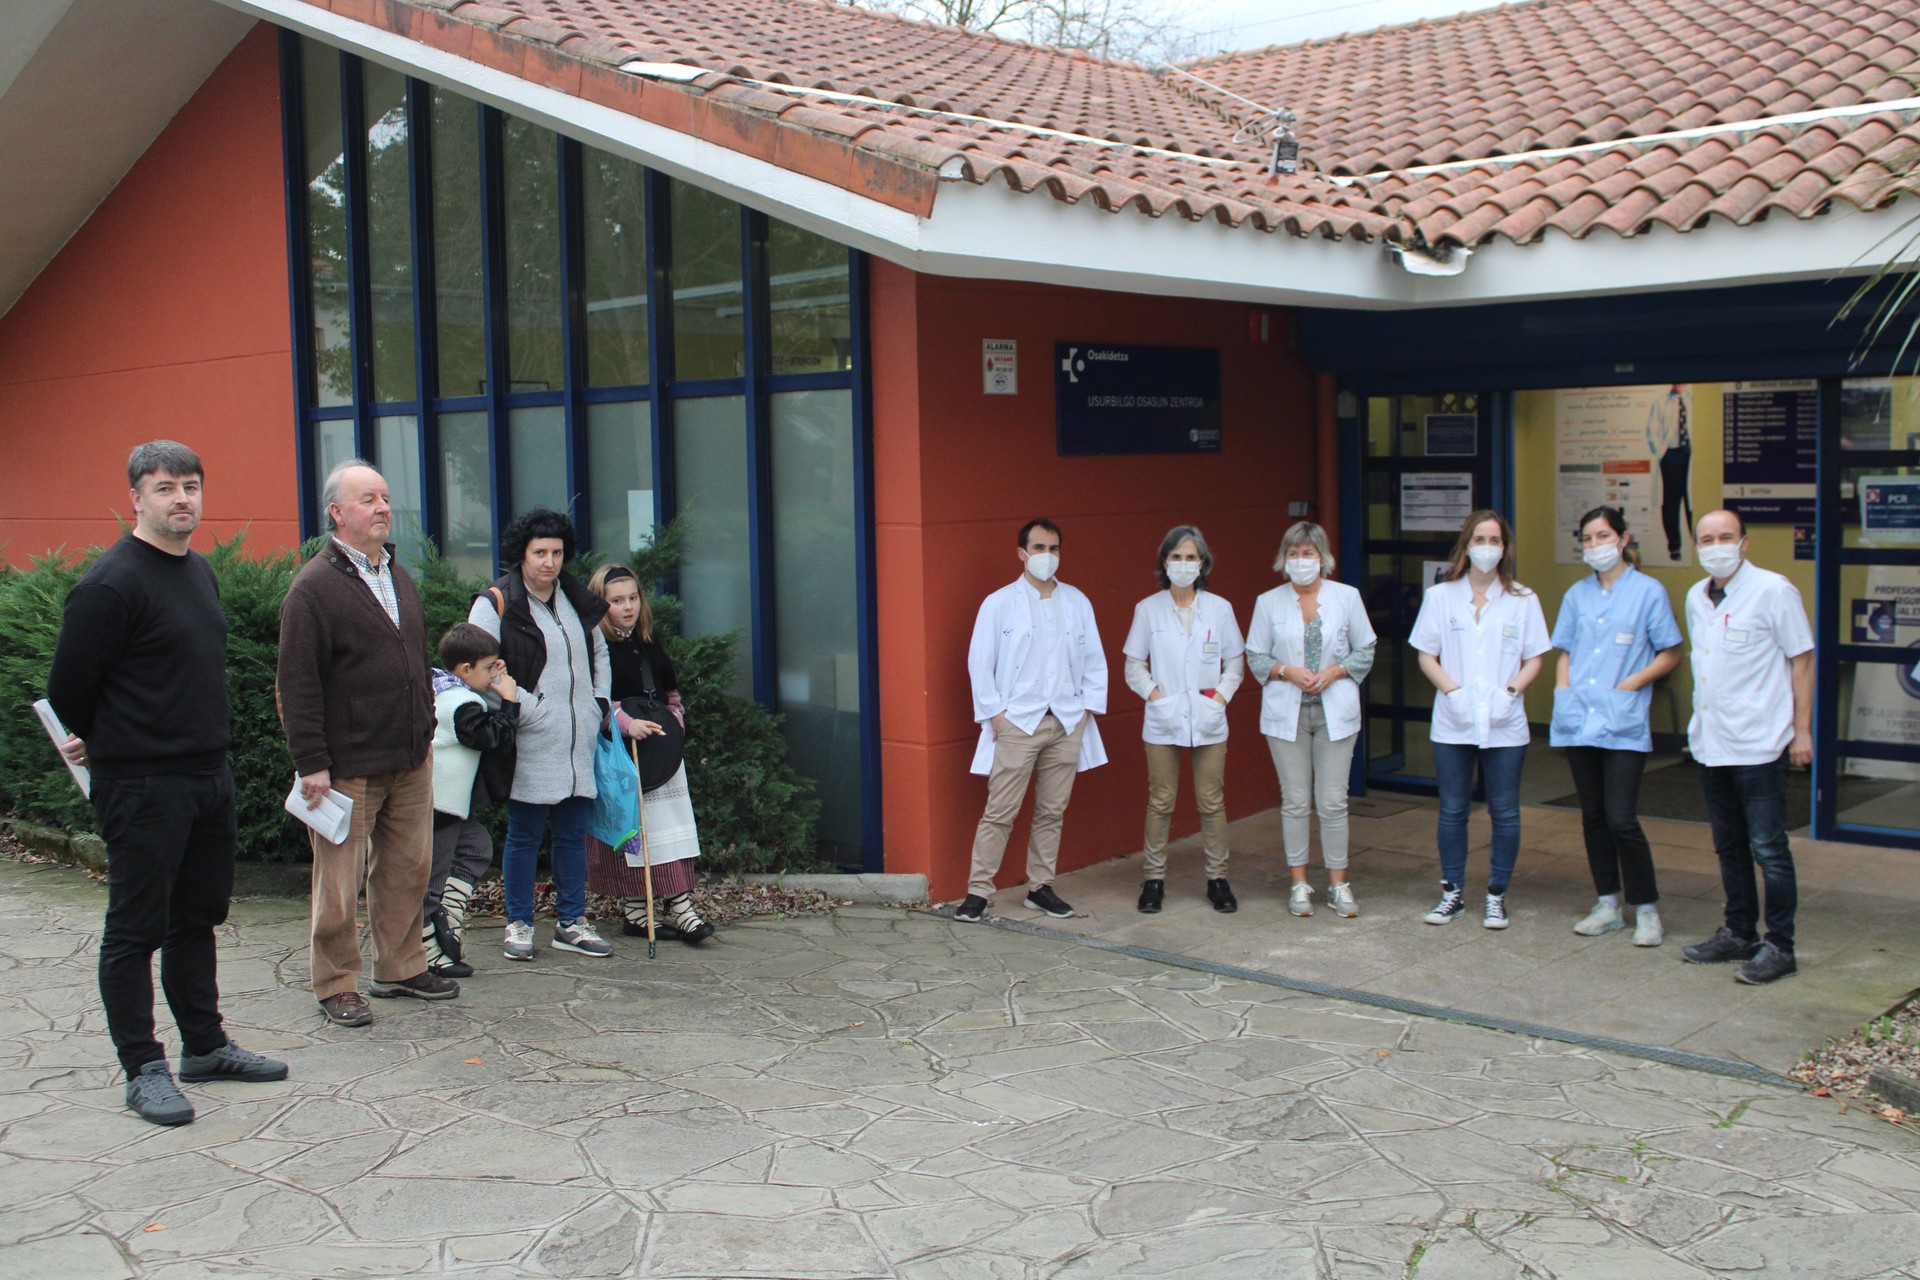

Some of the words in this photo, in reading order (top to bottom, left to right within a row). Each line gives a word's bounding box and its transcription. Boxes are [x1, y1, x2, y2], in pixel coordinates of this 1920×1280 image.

[986, 343, 1014, 351] ALARMA
[1087, 349, 1129, 362] Osakidetza
[1087, 396, 1135, 408] USURBILGO
[1136, 396, 1168, 408] OSASUN
[1169, 397, 1204, 409] ZENTROA
